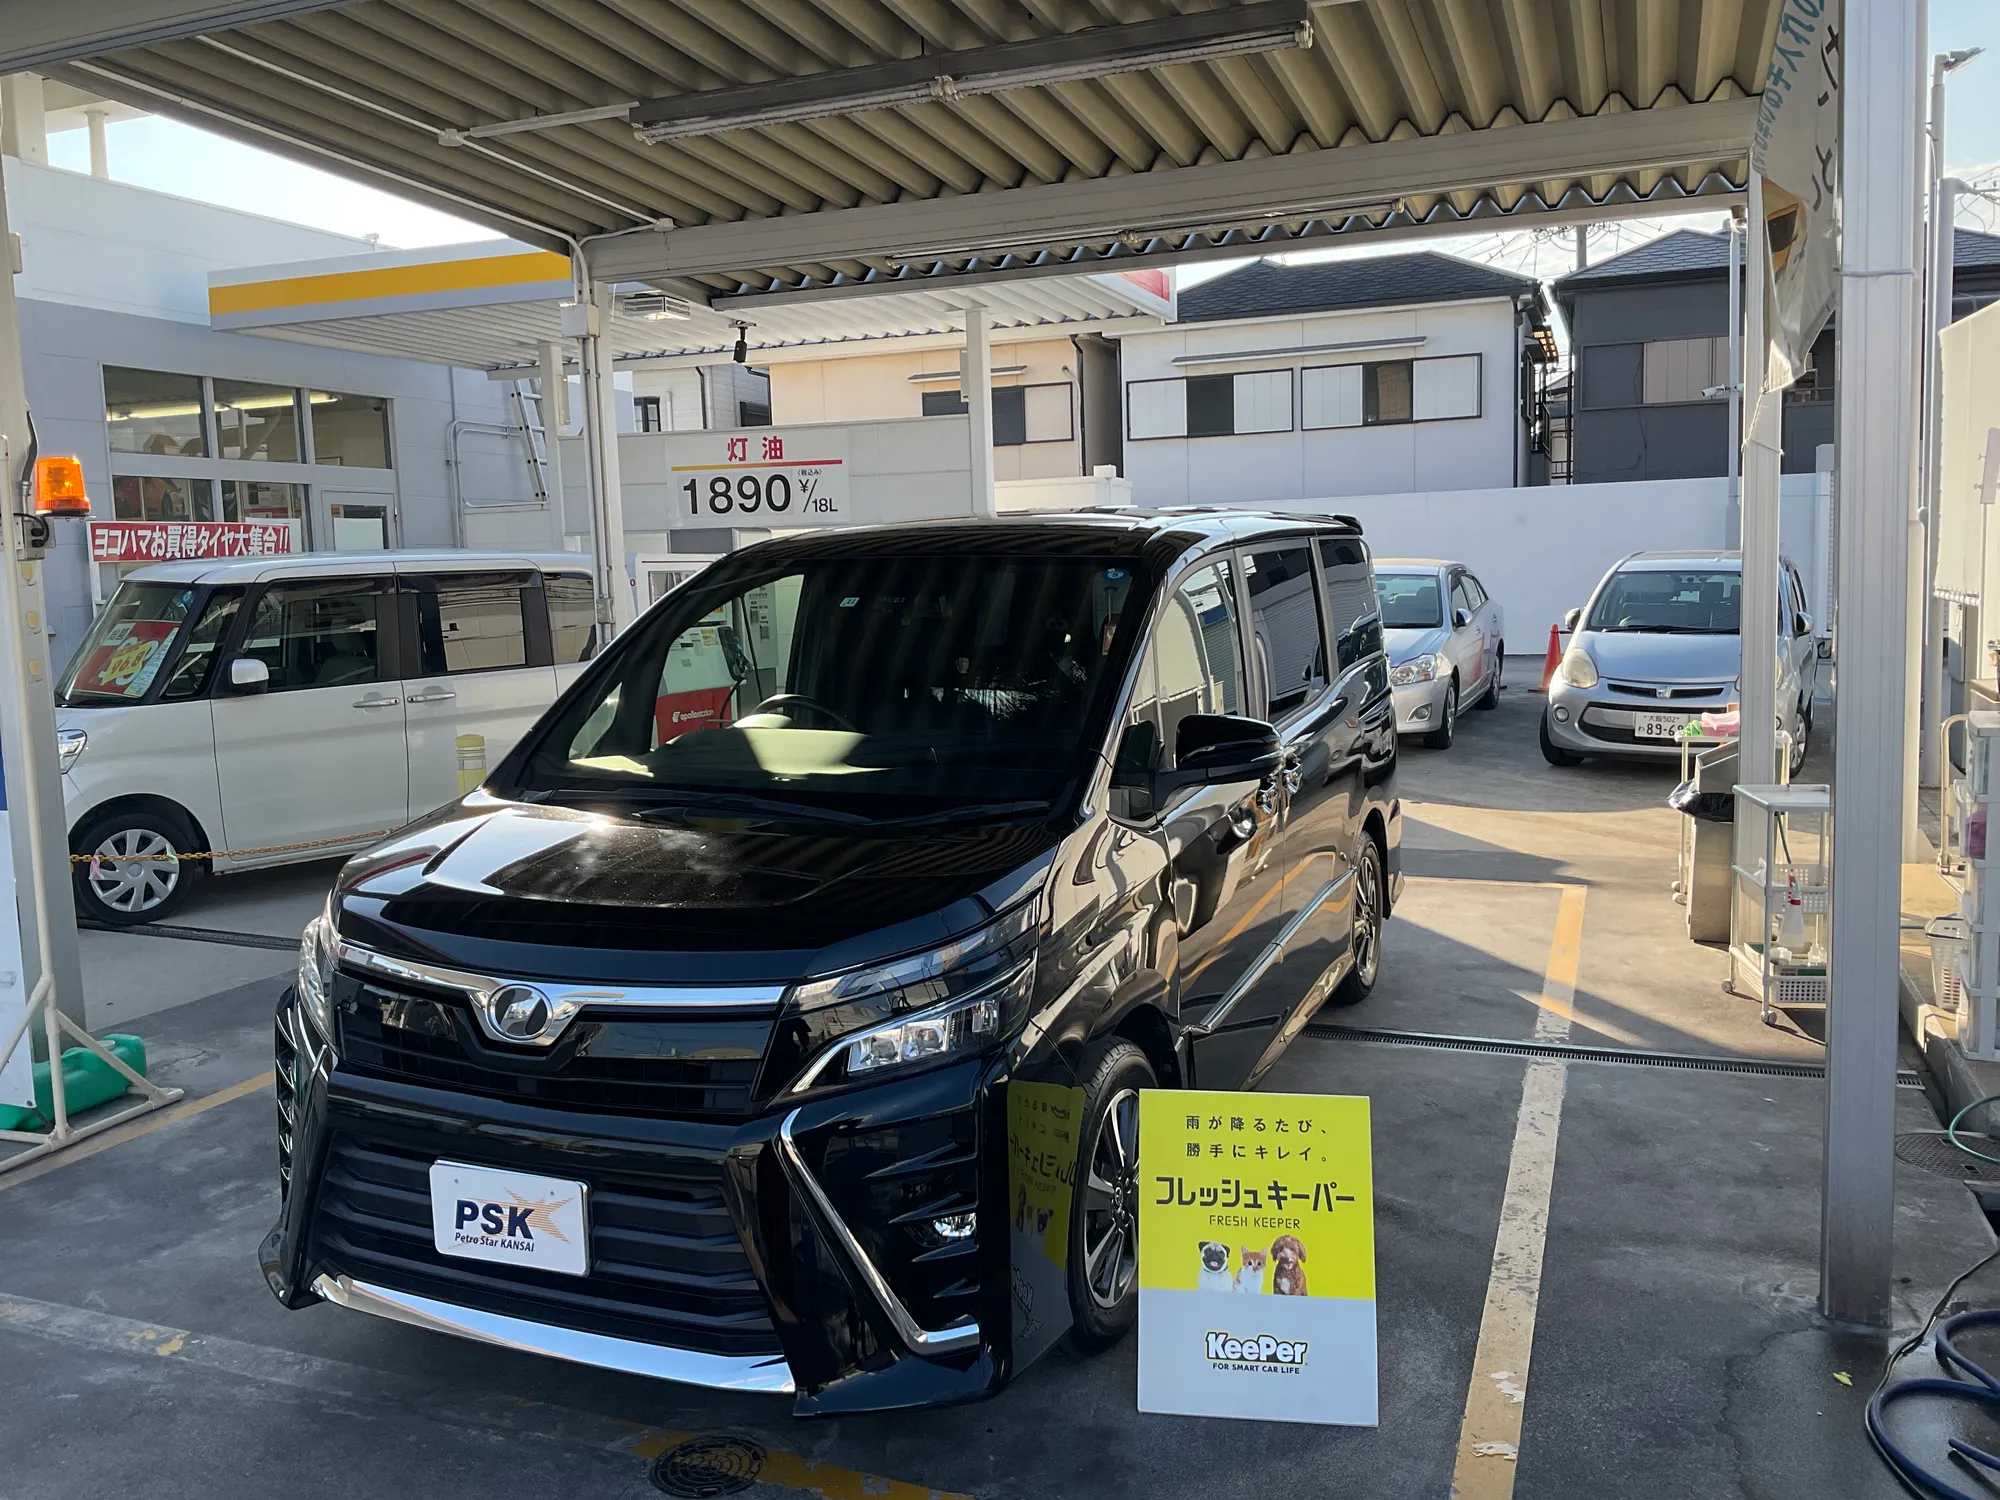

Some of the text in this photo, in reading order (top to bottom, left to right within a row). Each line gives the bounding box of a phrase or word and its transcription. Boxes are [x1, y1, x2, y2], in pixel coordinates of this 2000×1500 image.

[727, 435, 784, 462] 灯油
[683, 474, 791, 515] 1890
[1186, 1115, 1327, 1134] 雨が降るたび、
[1186, 1142, 1327, 1162] 勝手にキレイ。
[1156, 1176, 1355, 1212] フレッシュキーパー
[455, 1199, 535, 1240] PSK
[1209, 1214, 1300, 1229] FRESH KEEPER
[454, 1232, 535, 1252] Petro Star KANSAI
[1205, 1331, 1308, 1365] KeePer
[1212, 1362, 1300, 1375] FOR SMART CAR LIFE
